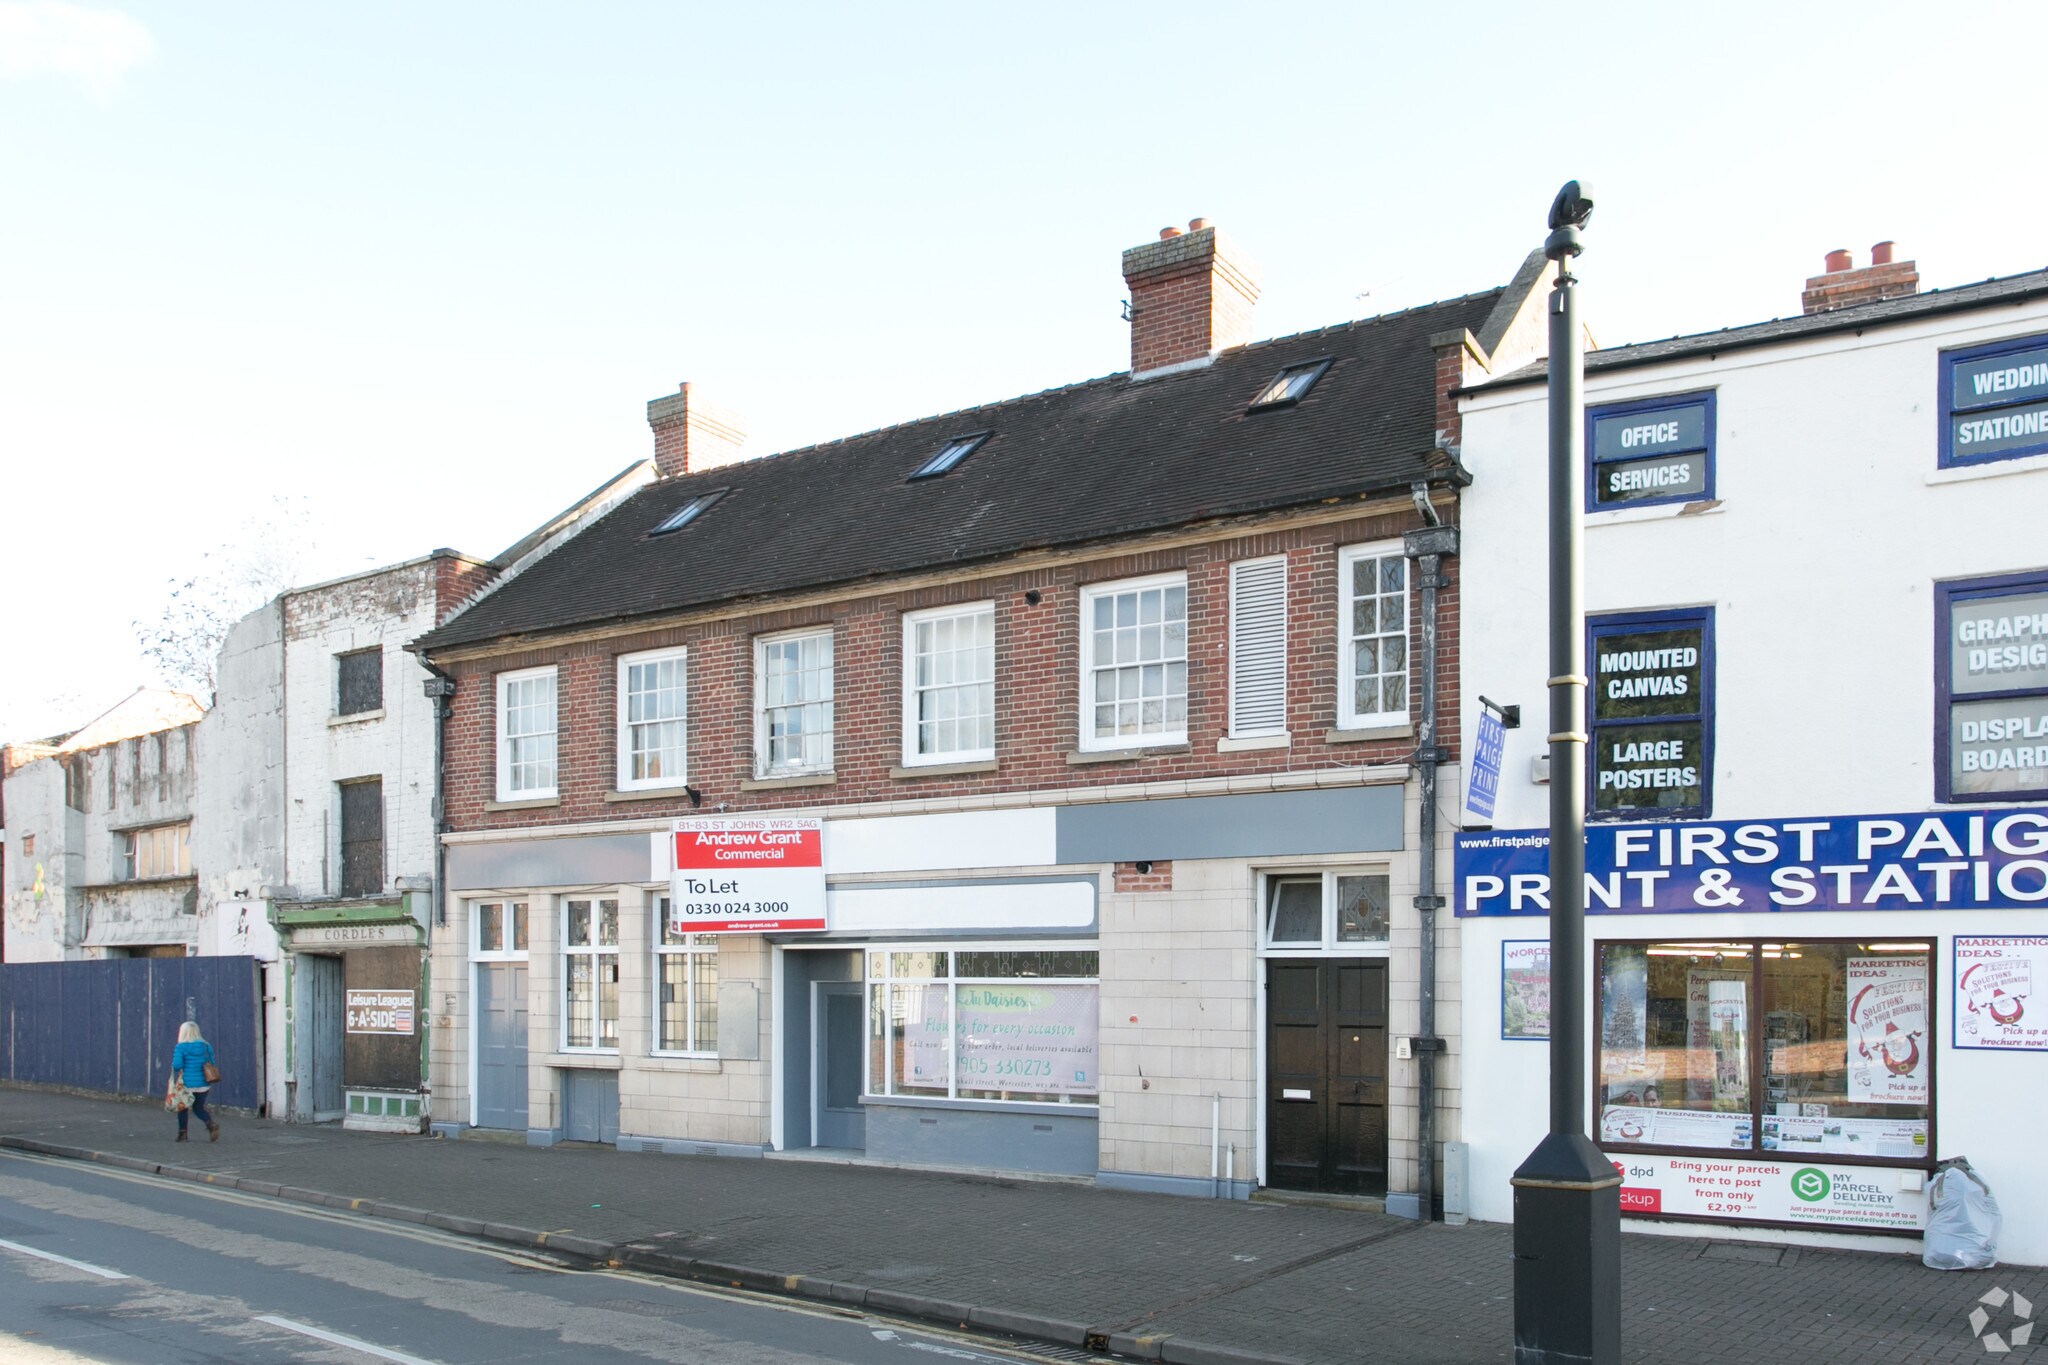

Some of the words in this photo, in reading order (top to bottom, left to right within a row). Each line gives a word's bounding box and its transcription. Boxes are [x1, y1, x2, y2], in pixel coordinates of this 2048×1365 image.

[1621, 421, 1678, 448] OFFICE
[1959, 410, 2048, 444] STATIONE
[1610, 463, 1690, 492] SERVICES
[1959, 613, 2048, 642] GRAPH
[1600, 647, 1697, 673] MOUNTED
[1969, 643, 2047, 670] DESIG
[1608, 675, 1688, 699] CANVAS
[1480, 717, 1506, 747] FIRST
[1475, 738, 1502, 768] PAIGE
[1613, 740, 1683, 763] LARGE
[1962, 745, 2048, 772] BOARD
[1471, 765, 1498, 793] PRINT
[1600, 766, 1697, 790] POSTERS
[678, 821, 708, 830] 81-83
[712, 820, 725, 830] ST
[730, 820, 766, 829] JOHNS
[770, 820, 793, 829] WR2
[797, 819, 817, 828] 5AG
[695, 831, 757, 846] Andrew
[759, 830, 802, 845] Grant
[1615, 822, 1830, 867] FIRST
[1857, 813, 2048, 860] PAIG
[714, 848, 784, 860] Commercial
[684, 879, 707, 894] To
[710, 879, 739, 894] Let
[1466, 870, 1669, 911] PRNT
[1693, 868, 1745, 908] &
[1768, 859, 2048, 906] STATIO
[686, 903, 721, 915] 0330
[724, 902, 750, 914] 024
[754, 901, 789, 913] 3000
[727, 921, 779, 930] andrew-grant.co.uk
[1957, 938, 2048, 947] MARKETING
[1849, 960, 1926, 968] MARKETING
[349, 993, 377, 1006] Leisure
[377, 993, 412, 1009] Leagues
[983, 990, 1027, 1007] Daisies
[1862, 994, 1905, 1020] SOLUTIONS
[971, 1018, 990, 1035] for
[992, 1023, 1024, 1038] every
[1028, 1020, 1076, 1036] occasion
[2003, 1027, 2023, 1035] Pick
[1980, 1037, 2022, 1046] brochure
[946, 1056, 987, 1074] 1905
[995, 1058, 1052, 1076] 330273
[1888, 1083, 1905, 1091] Pick
[1870, 1092, 1905, 1101] brochure
[1656, 1110, 1713, 1119] BUSINESS
[1715, 1114, 1786, 1123] MARKING
[1630, 1166, 1654, 1179] dpd
[1670, 1160, 1702, 1172] Bring
[1706, 1164, 1733, 1173] your
[1737, 1165, 1781, 1175] parcels
[1688, 1175, 1715, 1185] here
[1719, 1176, 1731, 1186] to
[1735, 1178, 1761, 1188] post
[1833, 1173, 1853, 1182] MY
[1695, 1188, 1724, 1198] from
[1727, 1190, 1754, 1202] only
[1833, 1183, 1883, 1194] PARCEL
[1620, 1192, 1655, 1207] ckup
[1833, 1193, 1894, 1203] DELIVERY
[1707, 1203, 1742, 1213] £2.99
[1869, 1210, 1883, 1218] drop
[1789, 1213, 1918, 1226] www.myparceldelivery.com
